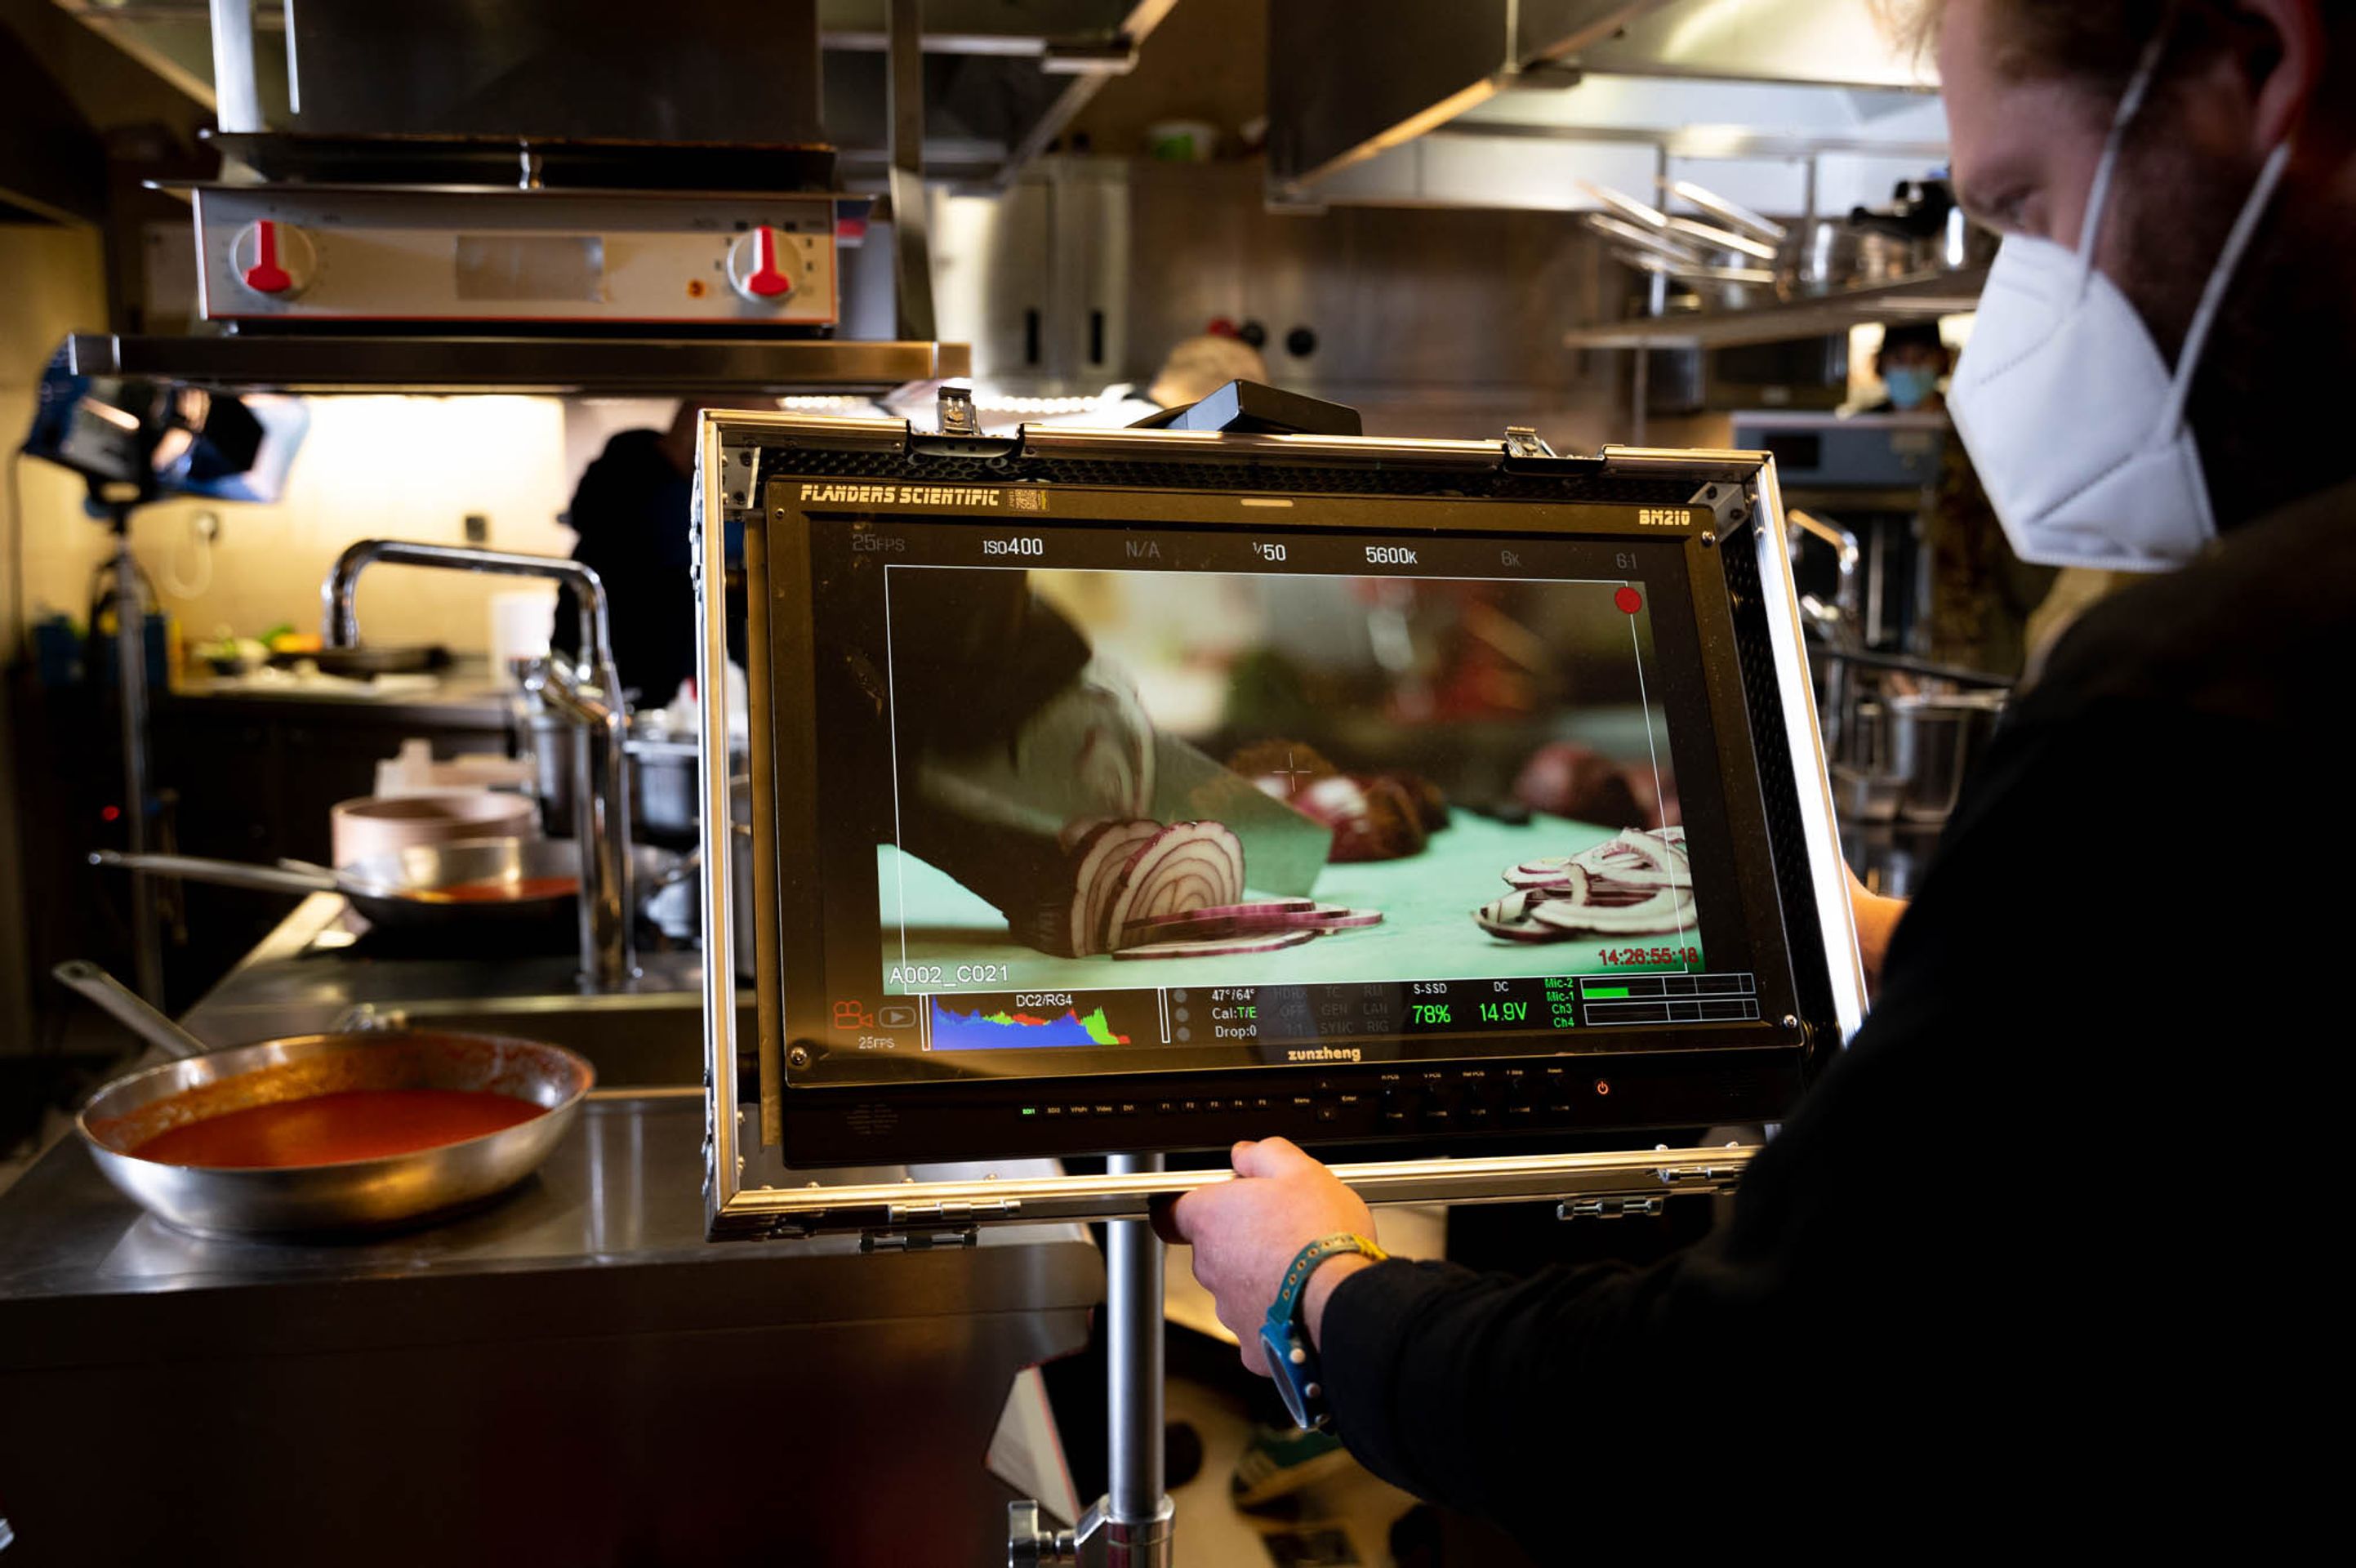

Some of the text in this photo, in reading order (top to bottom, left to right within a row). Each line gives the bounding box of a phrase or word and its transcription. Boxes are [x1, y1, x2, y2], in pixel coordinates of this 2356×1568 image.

[800, 484, 895, 504] FLANDERS
[898, 488, 1000, 506] SCIENTIFIC
[1638, 509, 1690, 526] BM210
[852, 533, 906, 553] 25FPS
[982, 537, 1043, 556] ISO400
[1125, 540, 1160, 559] N/A
[1365, 546, 1418, 565] 5600K
[1598, 947, 1699, 966] 14:28:55:18
[889, 965, 1009, 987] A002_C021
[1544, 978, 1574, 988] Mic-2
[1414, 983, 1447, 995] S-SSD
[1493, 982, 1509, 992] DC
[1546, 991, 1574, 1001] Mic-1
[1016, 994, 1073, 1007] DC2/RG4
[1552, 1003, 1573, 1014] Ch3
[1412, 1004, 1451, 1024] 78%
[1480, 1002, 1527, 1022] 14.9V
[1553, 1016, 1575, 1028] Ch4
[1288, 1045, 1361, 1062] zunzheng
